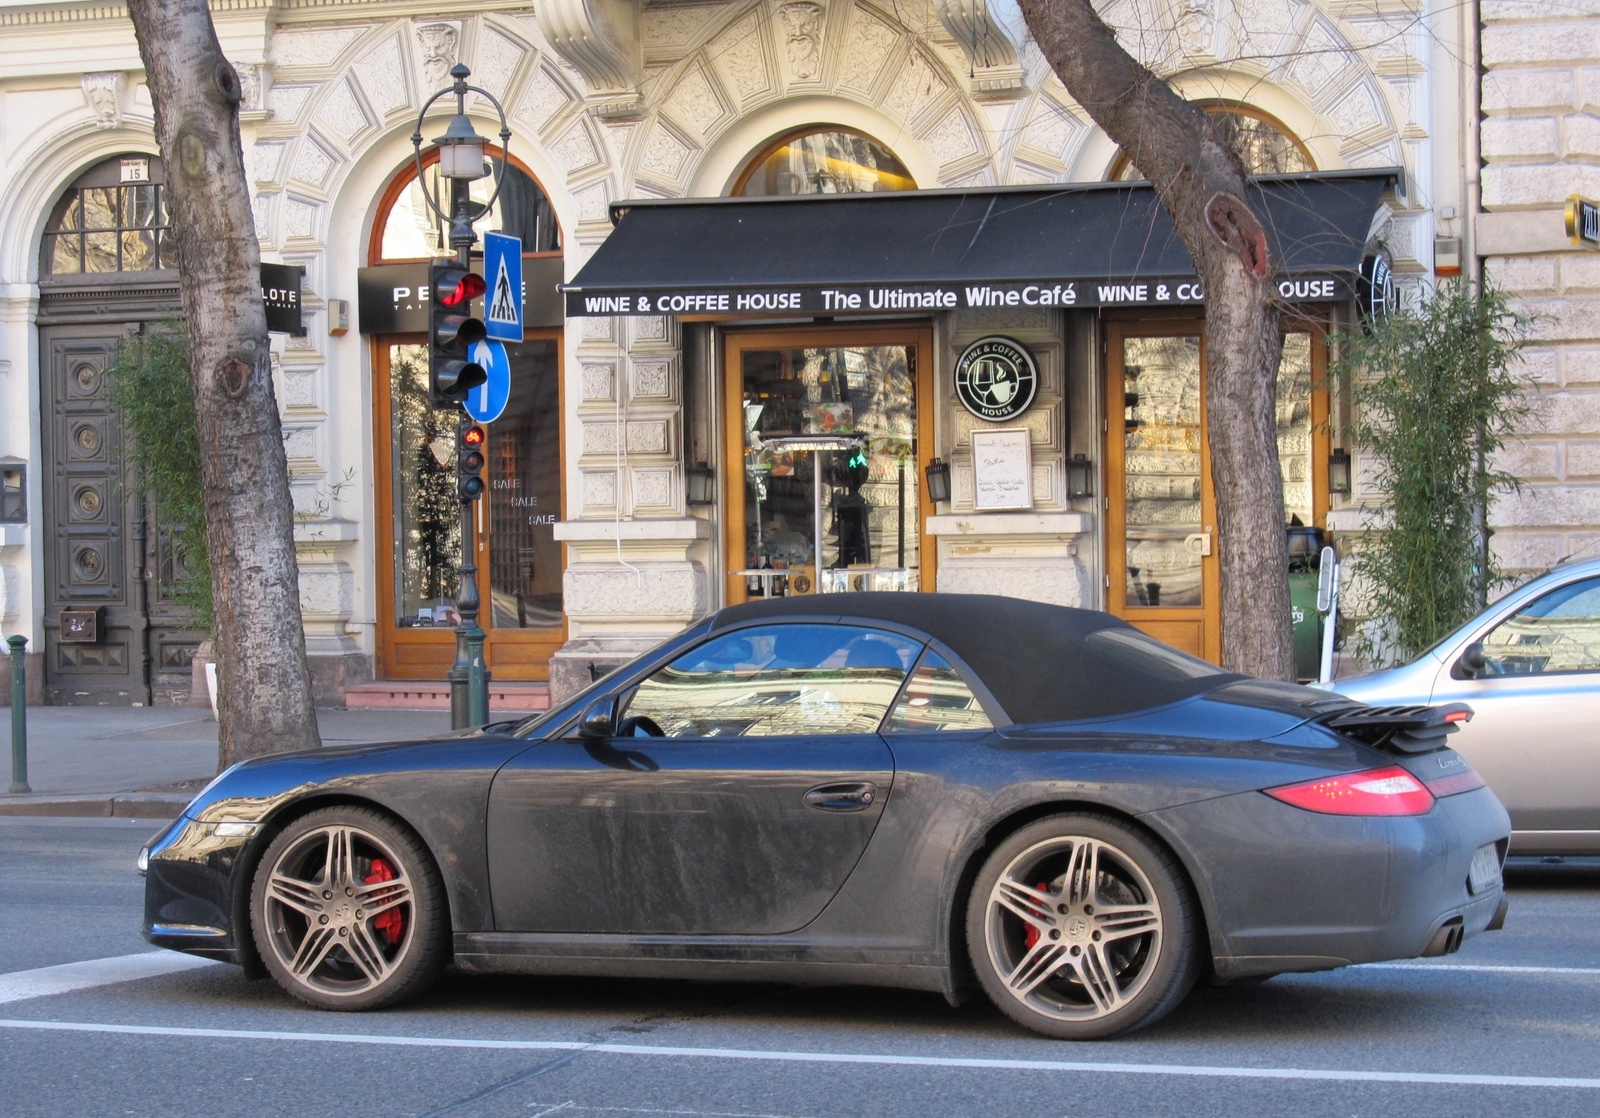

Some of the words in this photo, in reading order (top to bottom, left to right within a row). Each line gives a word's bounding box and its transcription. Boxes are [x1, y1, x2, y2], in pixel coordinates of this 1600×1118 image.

[130, 169, 140, 179] 15
[261, 287, 297, 303] LOTE
[1097, 284, 1147, 302] WINE
[1155, 283, 1170, 301] &
[1276, 280, 1334, 298] OUSE
[585, 296, 631, 312] WINE
[637, 296, 651, 312] &
[657, 294, 730, 311] COFFEE
[736, 293, 801, 310] HOUSE
[821, 291, 861, 309] The
[868, 288, 958, 309] Ultimate
[962, 347, 982, 368] WINE
[983, 344, 991, 353] &
[992, 344, 1023, 366] COFFEE
[981, 405, 1014, 416] HOUSE
[493, 479, 520, 490] SALE
[511, 496, 538, 507] SALE
[528, 514, 556, 526] SALE
